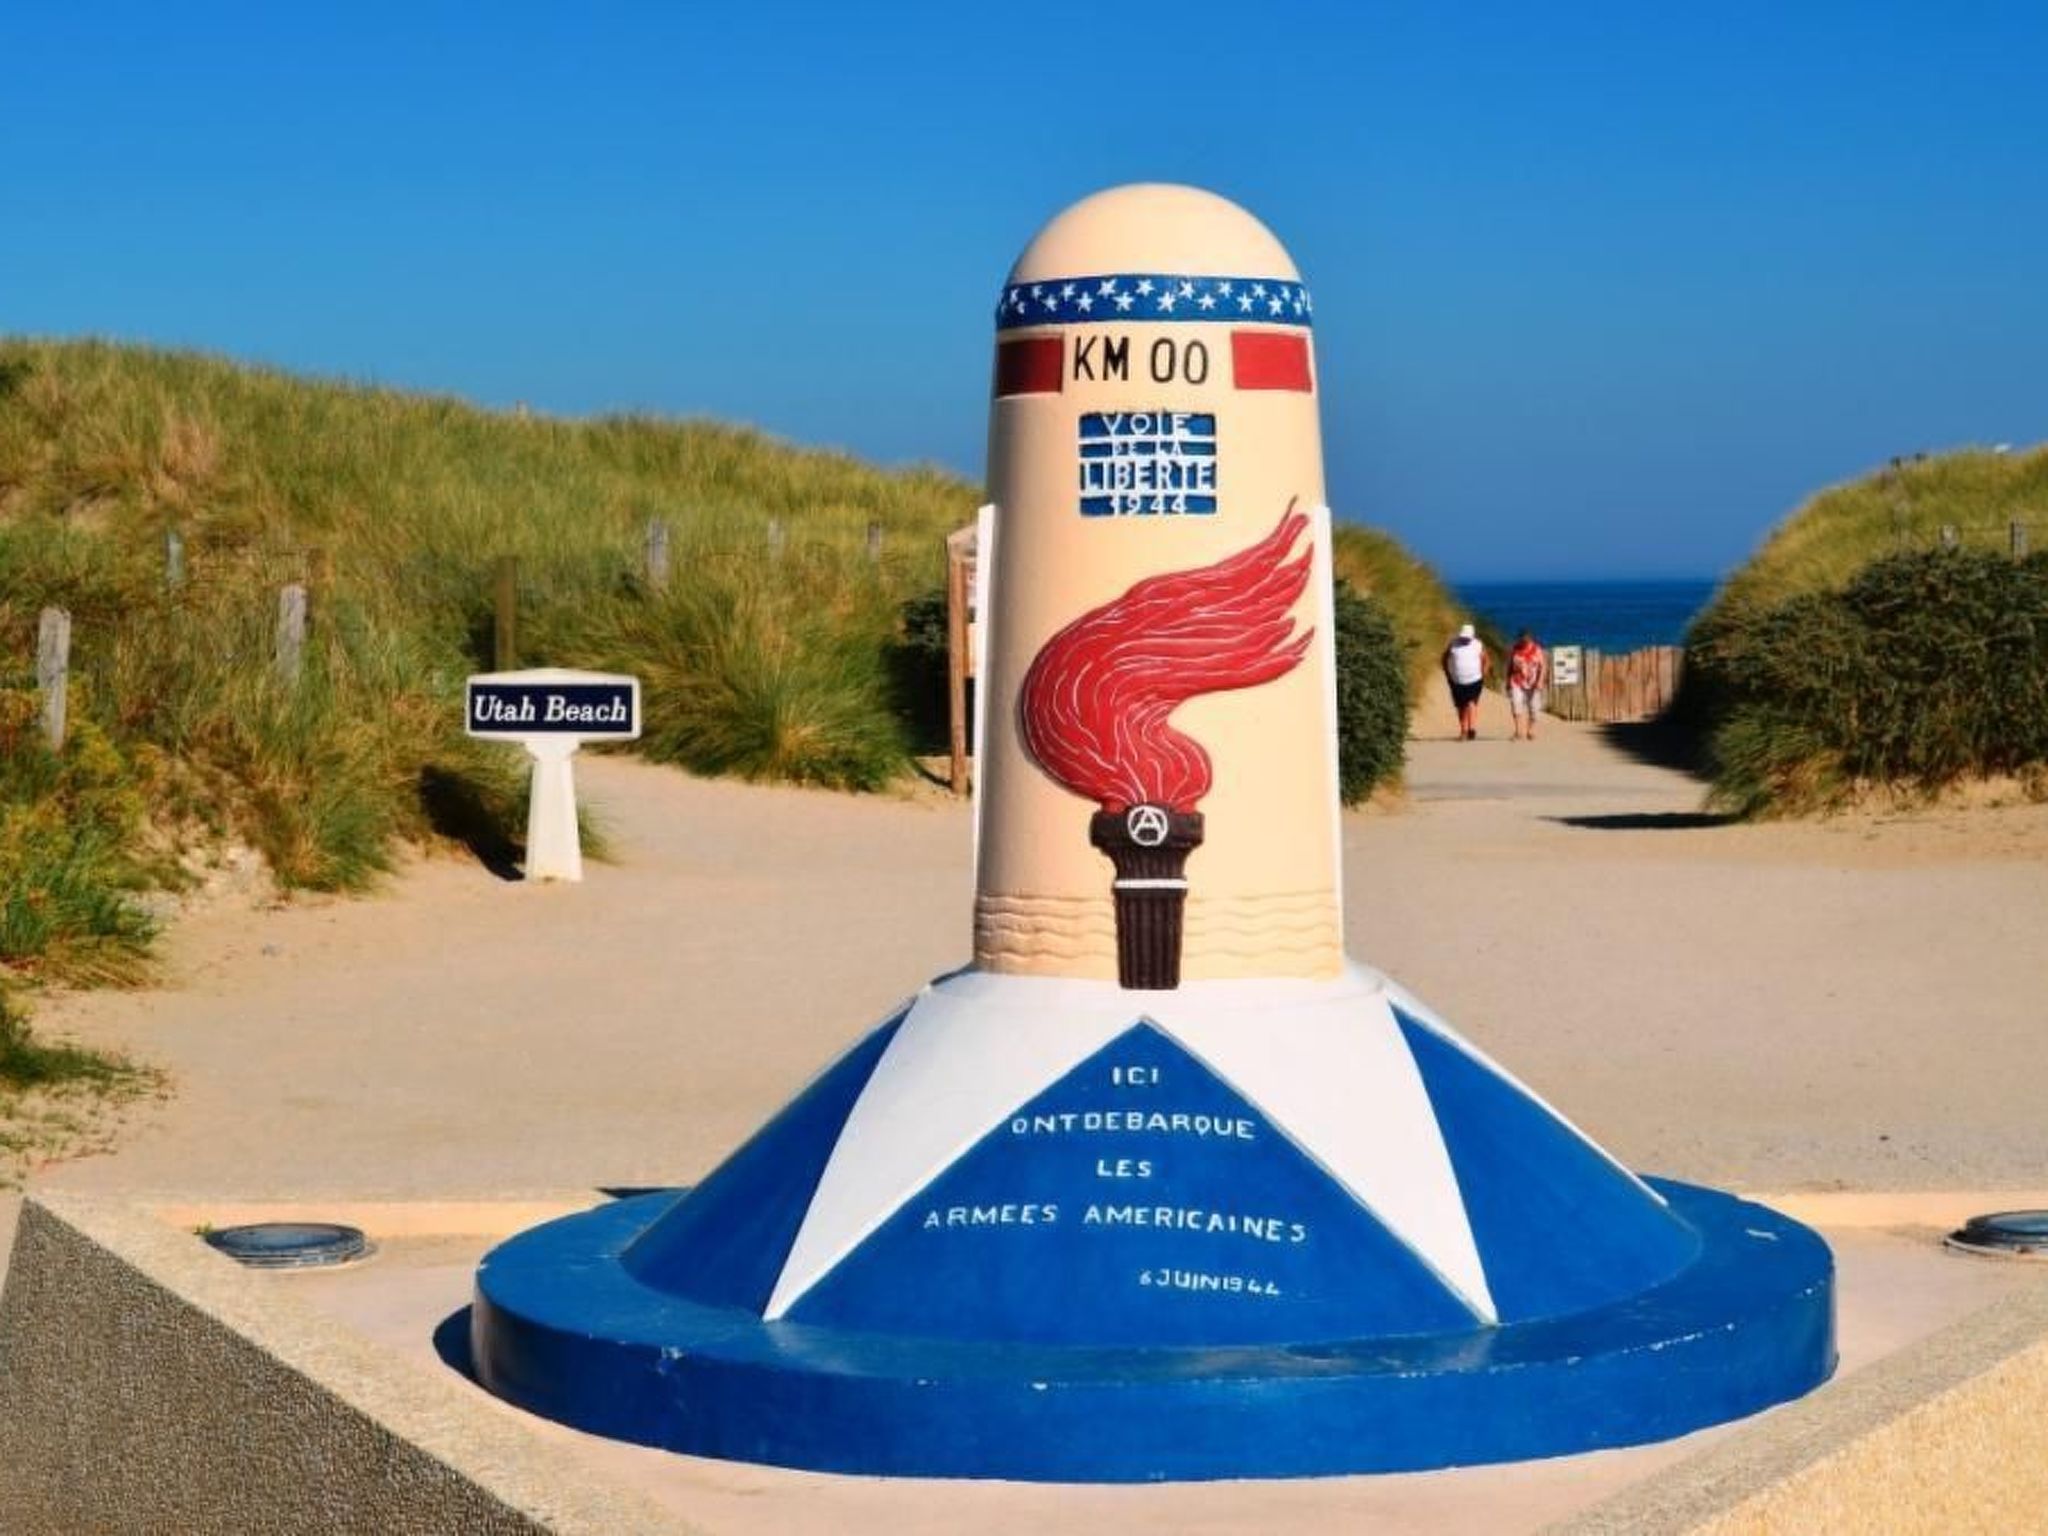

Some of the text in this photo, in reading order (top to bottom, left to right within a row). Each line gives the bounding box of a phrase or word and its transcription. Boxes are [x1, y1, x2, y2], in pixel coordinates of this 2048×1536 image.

[1072, 335, 1130, 382] KM
[1101, 413, 1193, 437] VOIE
[1155, 440, 1183, 457] LA
[1083, 459, 1213, 491] LIBERTE
[1109, 494, 1188, 515] 1944
[474, 694, 628, 722] Utah Beach
[1111, 1066, 1159, 1086] ICI
[1096, 1158, 1153, 1178] LES
[924, 1204, 1308, 1243] ARMEES AMERICAINES
